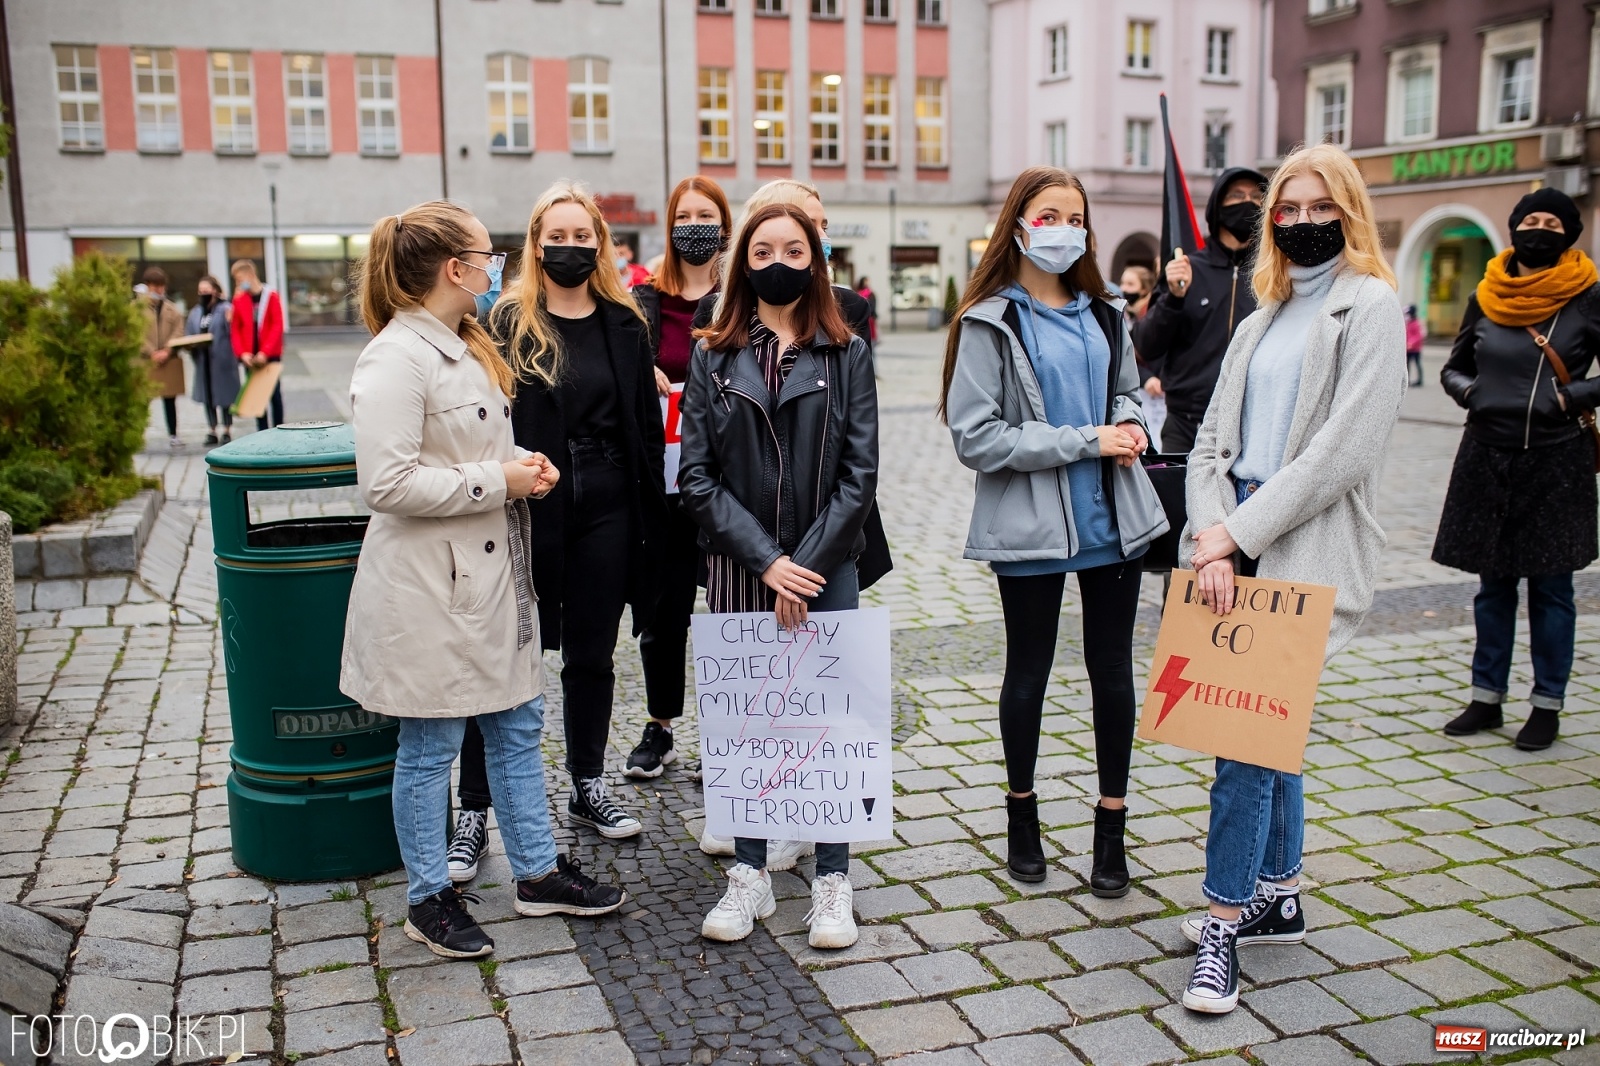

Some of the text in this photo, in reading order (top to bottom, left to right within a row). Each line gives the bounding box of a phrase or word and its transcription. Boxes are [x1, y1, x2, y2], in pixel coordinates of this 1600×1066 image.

[1393, 141, 1515, 179] KANTOR
[1232, 585, 1312, 615] WON'T
[1211, 620, 1254, 655] GO
[697, 655, 840, 685] DZIECI Z
[699, 687, 850, 718] MIŁOŚCI I
[822, 742, 836, 759] A
[844, 742, 880, 759] NIE
[708, 767, 730, 788] Z
[741, 767, 849, 790] GWAŁTU
